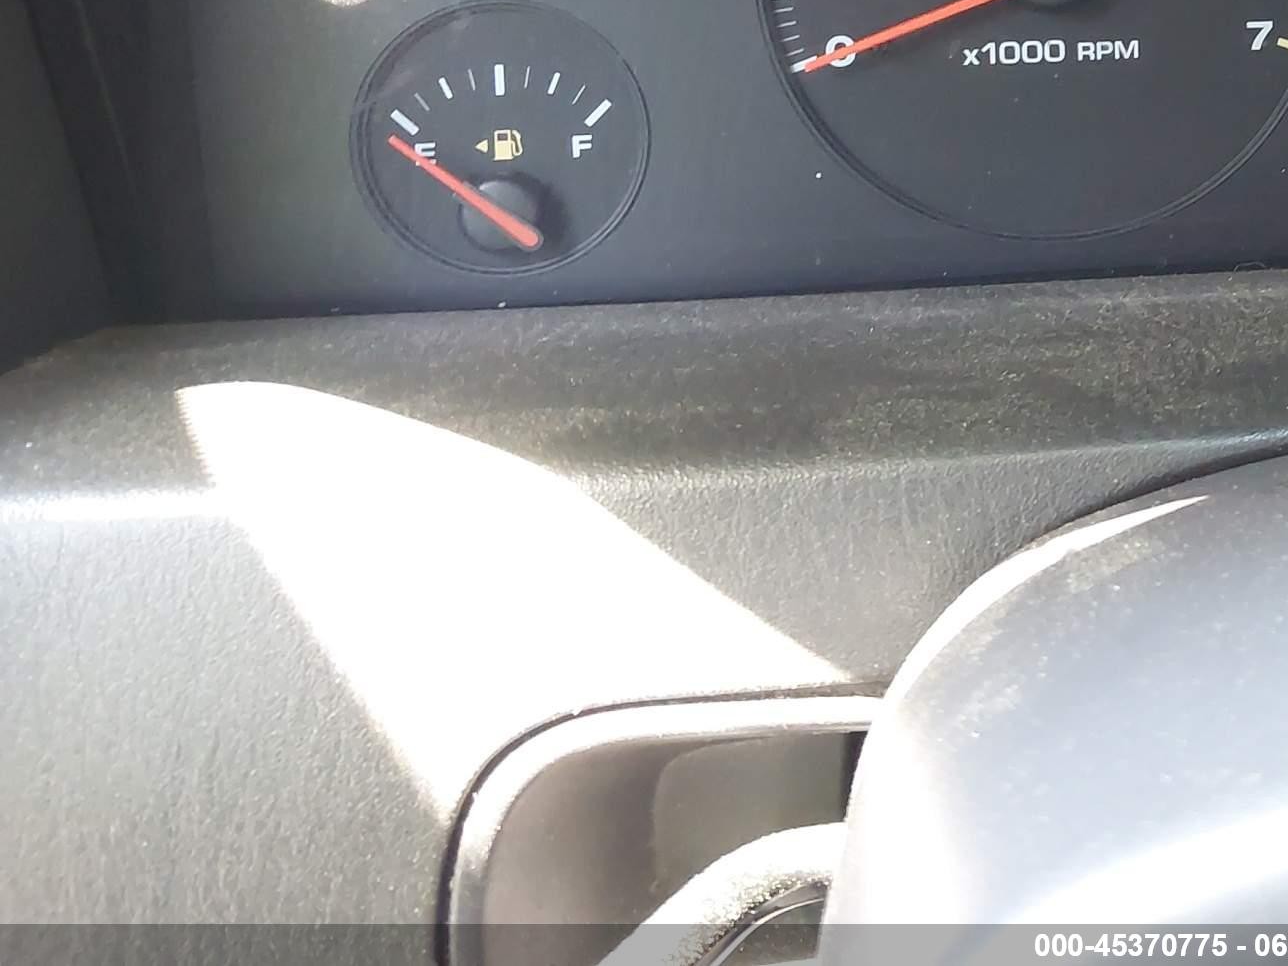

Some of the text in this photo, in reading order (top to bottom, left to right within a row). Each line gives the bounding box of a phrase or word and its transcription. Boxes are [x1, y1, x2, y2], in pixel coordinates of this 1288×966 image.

[1247, 21, 1273, 50] 7
[826, 36, 856, 67] 0
[963, 40, 1138, 65] x1000 RPM
[415, 142, 437, 166] E
[572, 135, 592, 158] F
